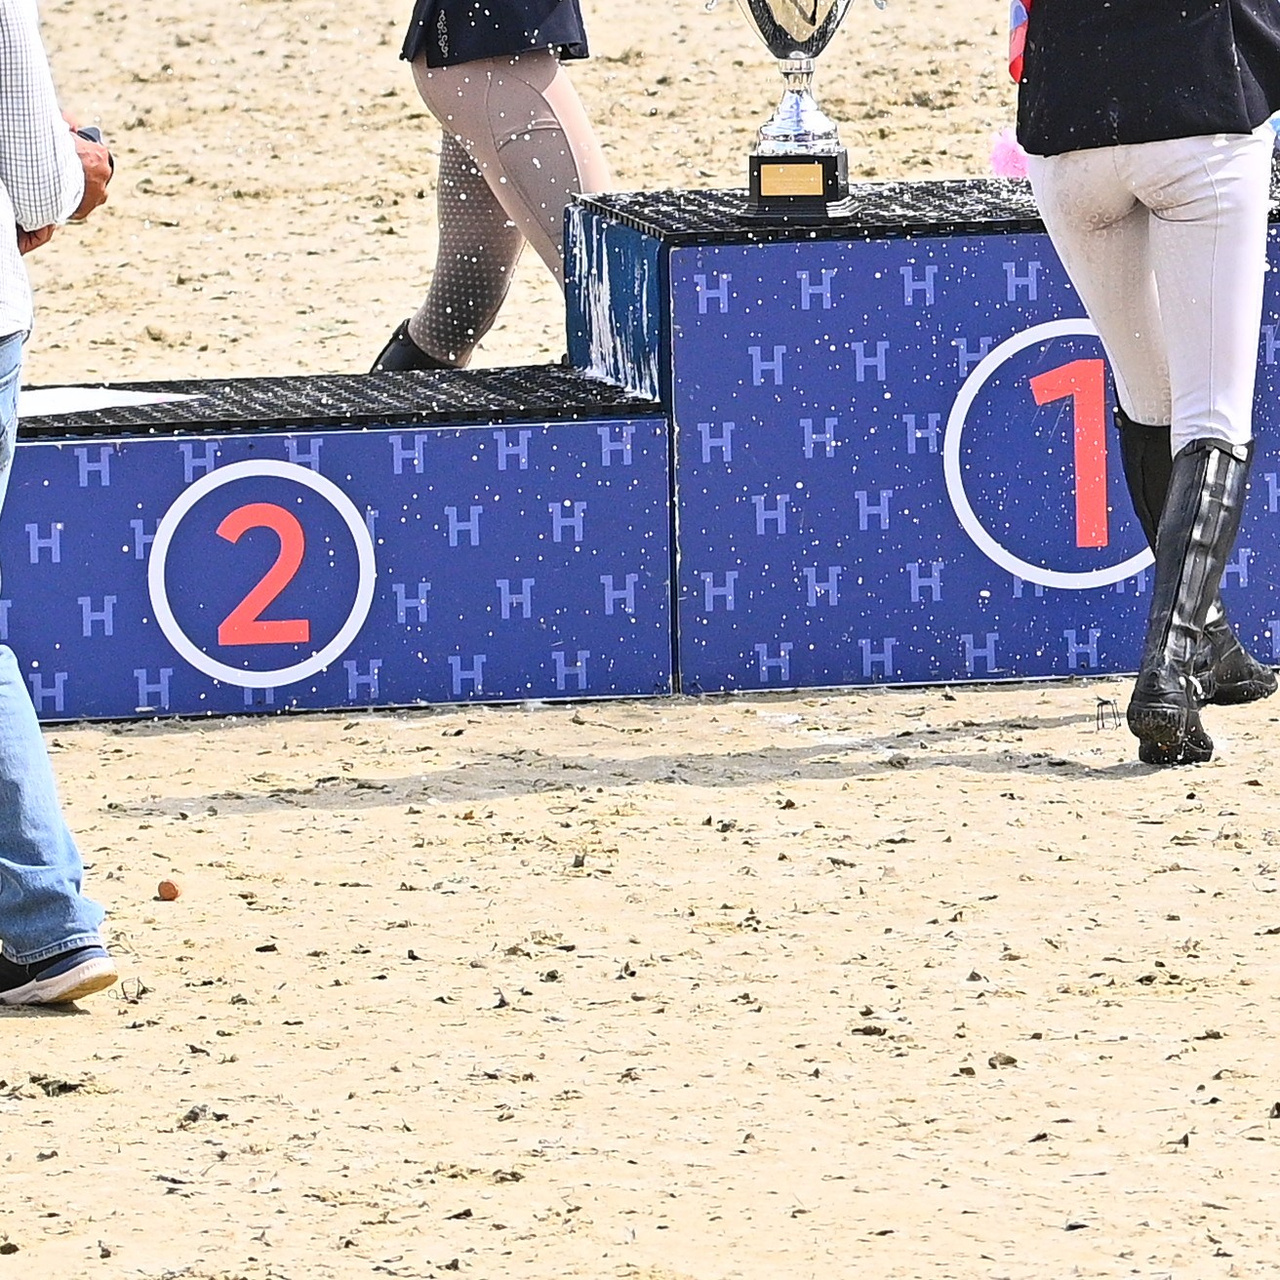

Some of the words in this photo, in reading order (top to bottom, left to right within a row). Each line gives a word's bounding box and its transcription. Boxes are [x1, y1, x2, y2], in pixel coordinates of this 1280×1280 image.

[695, 275, 733, 315] H
[798, 270, 838, 311] H
[901, 266, 939, 306] H
[1004, 262, 1042, 302] H
[749, 346, 787, 387] H
[851, 342, 890, 383] H
[956, 337, 993, 378] H
[494, 431, 533, 471] H
[598, 427, 636, 467] H
[698, 423, 736, 464] H
[801, 418, 839, 459] H
[904, 414, 942, 455] H
[1029, 359, 1108, 547] 1
[75, 448, 114, 488] H
[179, 442, 219, 483] H
[285, 438, 324, 473] H
[390, 435, 428, 475] H
[445, 507, 484, 547] H
[549, 503, 588, 543] H
[753, 495, 791, 536] H
[856, 491, 893, 531] H
[26, 524, 62, 564] H
[216, 502, 310, 645] 2
[802, 567, 842, 608] H
[907, 560, 946, 603] H
[1220, 548, 1251, 588] H
[393, 582, 432, 624] H
[497, 579, 536, 620] H
[601, 574, 639, 616] H
[702, 572, 739, 612] H
[79, 597, 118, 637] H
[756, 643, 794, 682] H
[859, 639, 898, 677] H
[960, 634, 1000, 675] H
[1065, 629, 1102, 669] H
[135, 669, 173, 708] H
[344, 660, 383, 698] H
[449, 656, 487, 695] H
[553, 651, 591, 691] H
[29, 672, 68, 711] H
